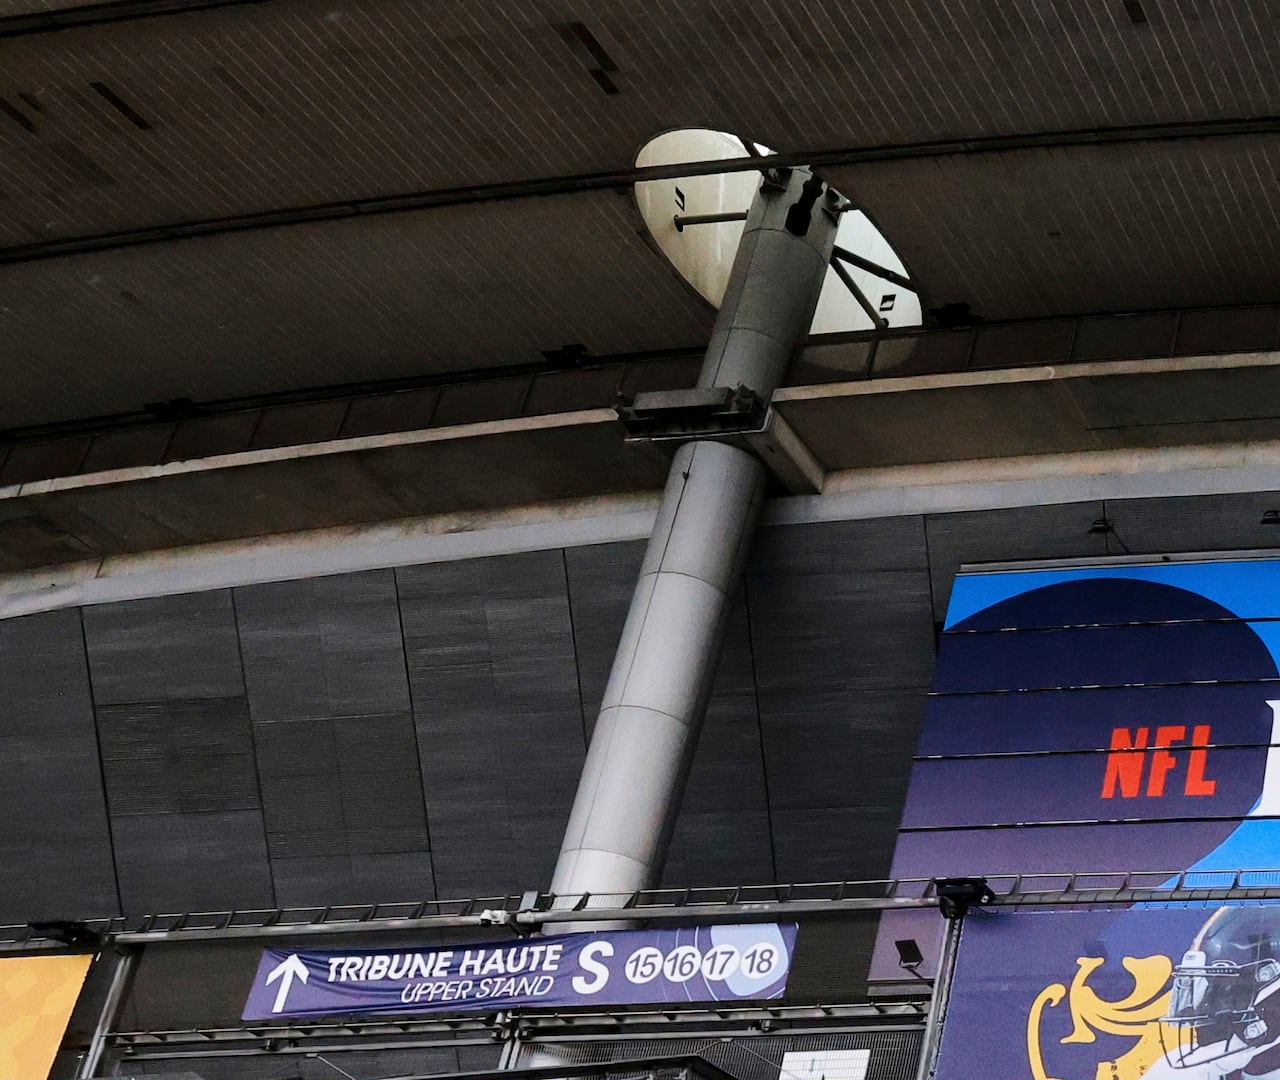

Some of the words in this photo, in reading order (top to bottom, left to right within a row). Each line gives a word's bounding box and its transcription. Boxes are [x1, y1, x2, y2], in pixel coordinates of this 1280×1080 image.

[1102, 724, 1216, 798] NFL
[327, 952, 449, 982] TRIBUNE
[459, 944, 563, 976] HAUTE
[571, 941, 614, 994] S
[628, 953, 659, 978] 15
[666, 952, 696, 976] 16
[704, 951, 735, 975] 17
[745, 949, 774, 974] 18
[401, 980, 474, 1003] UPPER
[475, 975, 555, 998] STAND
